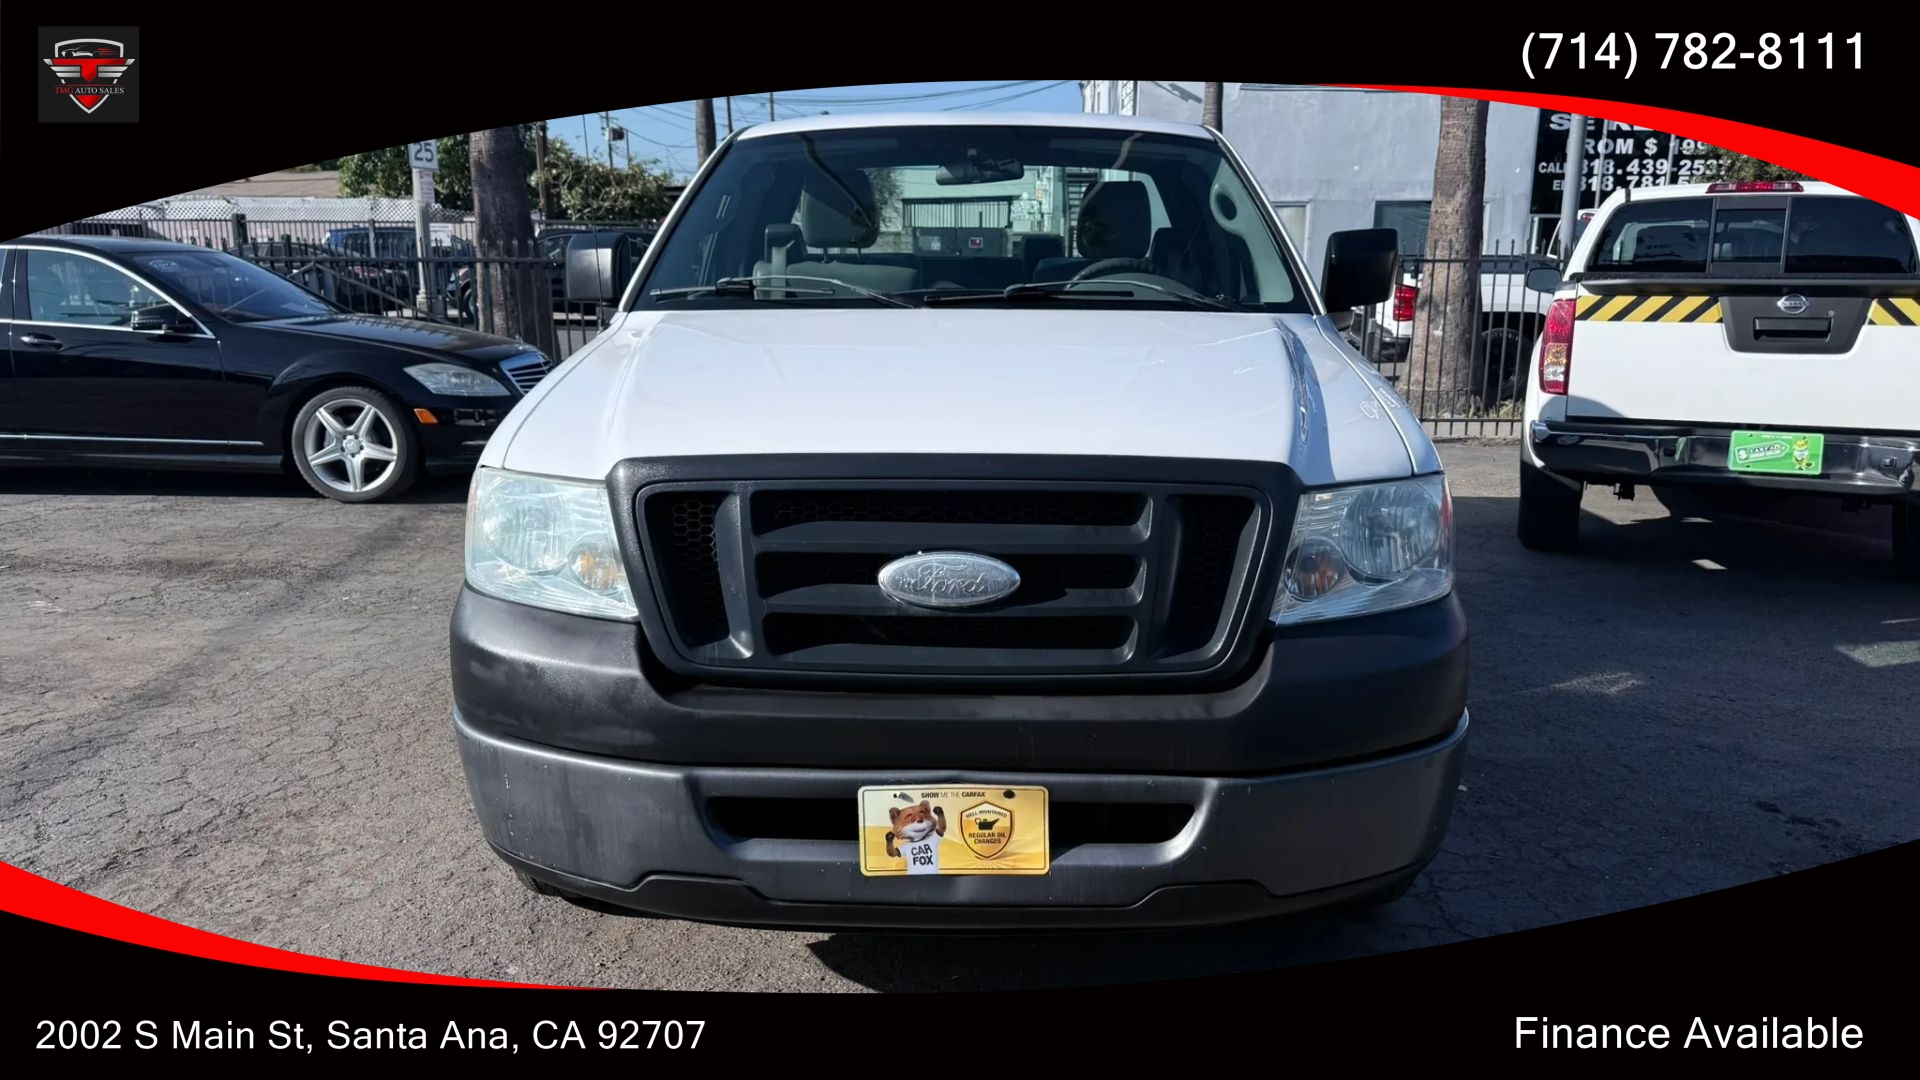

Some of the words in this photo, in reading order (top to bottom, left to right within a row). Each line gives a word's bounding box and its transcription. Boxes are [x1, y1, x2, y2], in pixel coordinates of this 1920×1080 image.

[414, 142, 434, 163] 25
[1567, 137, 1635, 156] ROM
[912, 562, 985, 594] Ford
[920, 791, 940, 799] SHOW
[911, 843, 933, 856] CAR
[912, 855, 934, 866] FOX
